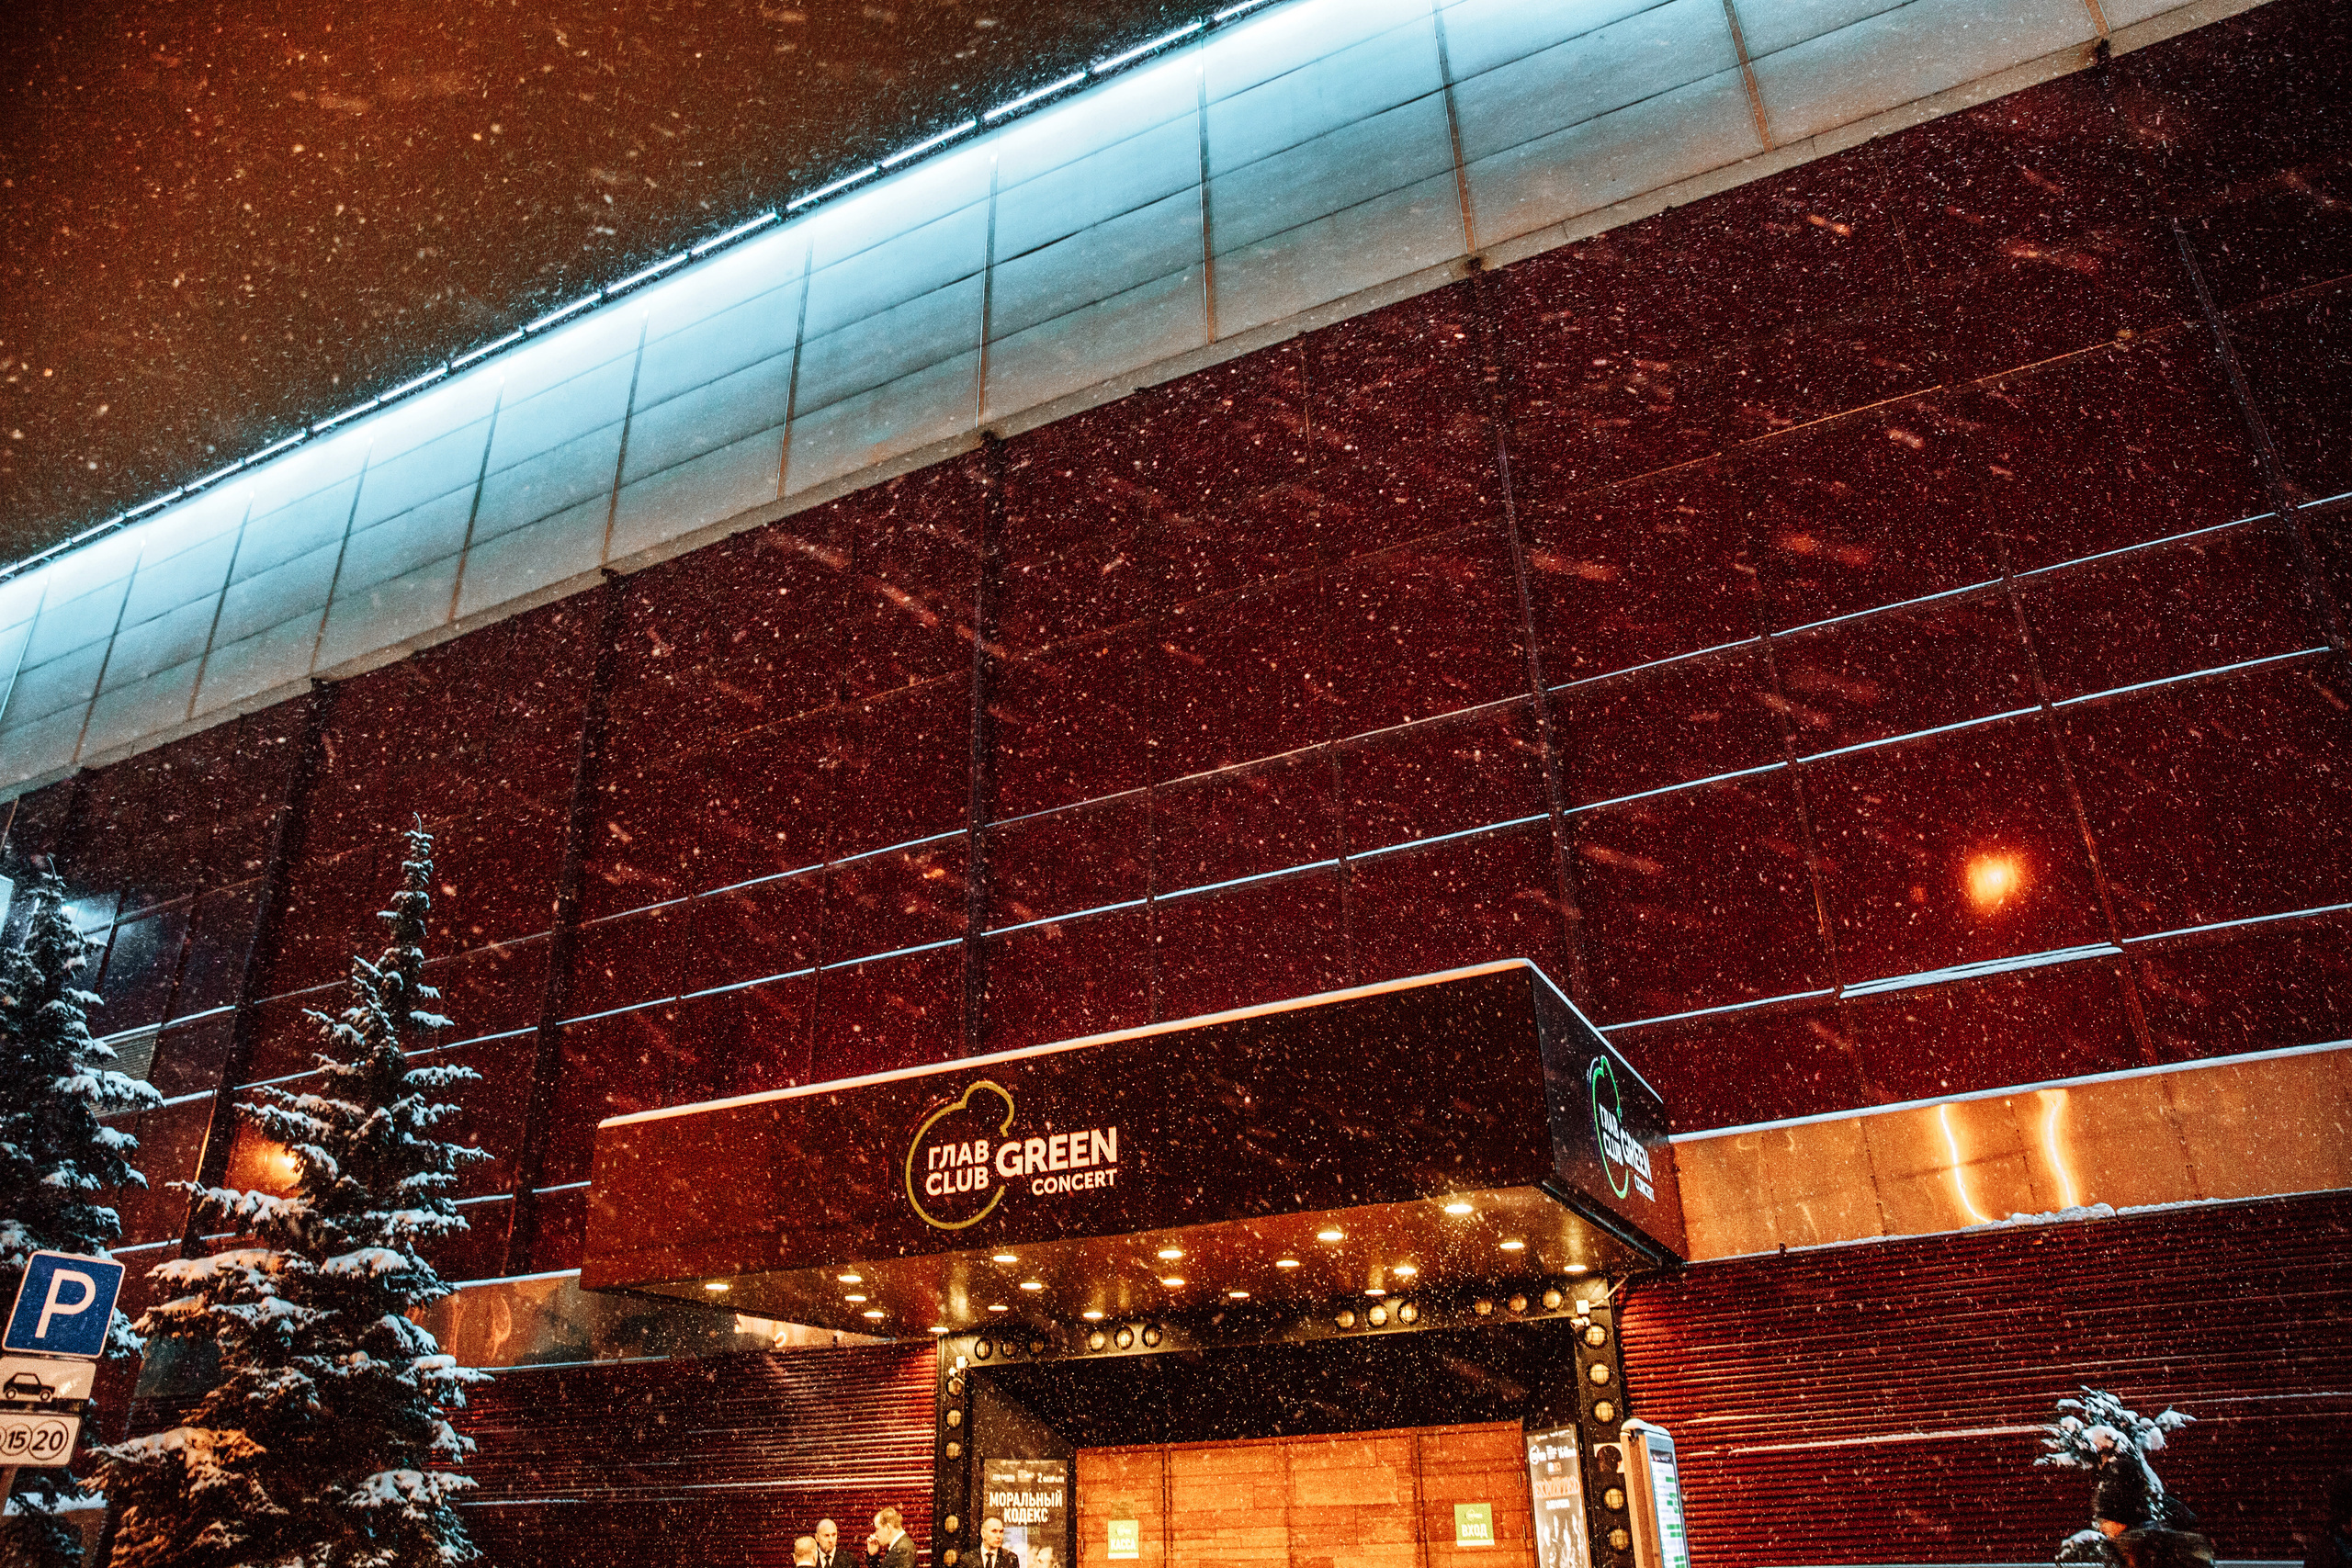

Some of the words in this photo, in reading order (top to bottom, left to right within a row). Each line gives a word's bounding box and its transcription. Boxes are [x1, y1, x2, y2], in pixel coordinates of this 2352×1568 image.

[928, 1139, 989, 1170] ГЛАВ
[995, 1126, 1117, 1178] GREEN
[1602, 1131, 1623, 1166] CLUB
[1620, 1128, 1653, 1182] GREEN
[925, 1166, 989, 1196] CLUB
[1031, 1169, 1117, 1196] CONCERT
[35, 1269, 96, 1338] P
[8, 1430, 27, 1449] 15
[32, 1429, 63, 1450] 20
[1037, 1472, 1043, 1483] 2
[989, 1490, 1063, 1507] МОРАЛЬНЫЙ
[1003, 1507, 1048, 1525] КОДЕКС
[1110, 1538, 1136, 1551] КАССА
[1462, 1523, 1488, 1539] ВХОД
